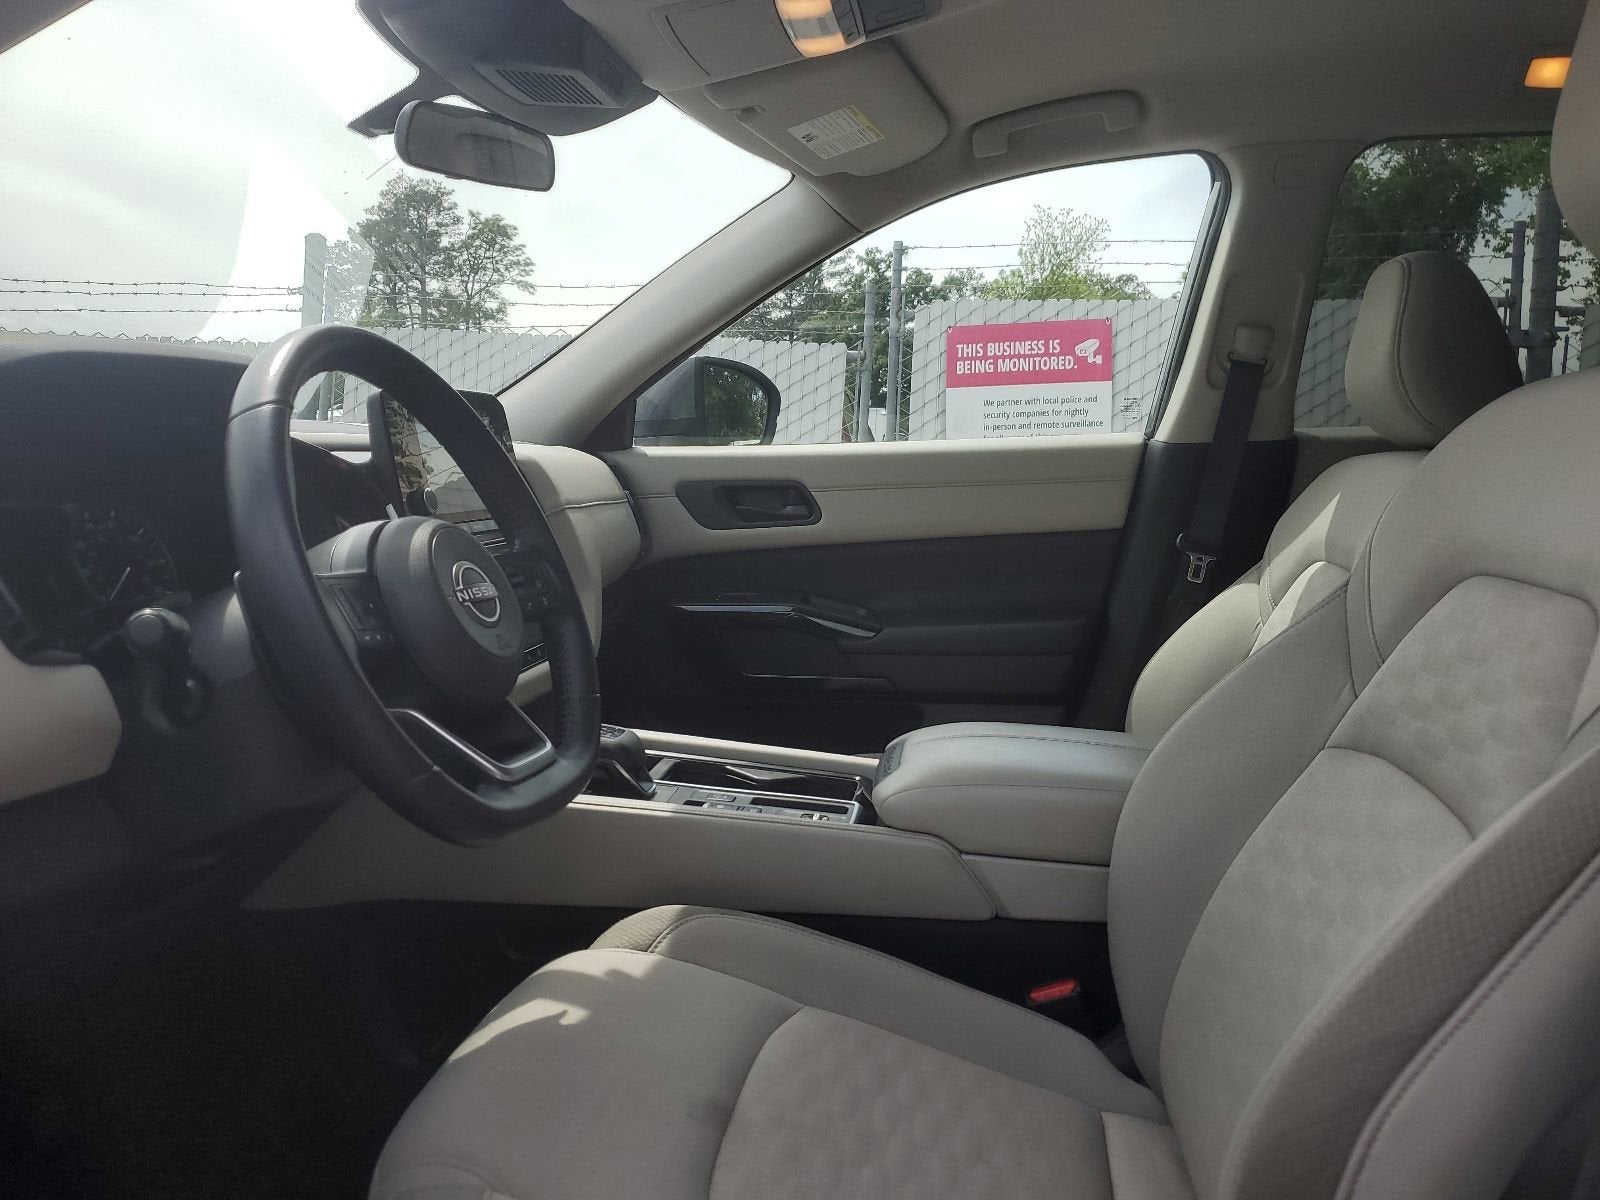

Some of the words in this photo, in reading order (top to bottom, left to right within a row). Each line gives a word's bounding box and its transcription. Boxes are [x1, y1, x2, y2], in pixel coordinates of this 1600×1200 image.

[956, 343, 984, 358] THIS
[987, 340, 1045, 356] BUSINESS
[1049, 339, 1060, 353] IS
[956, 359, 994, 375] BEING
[997, 355, 1078, 373] MONITORED.
[983, 399, 994, 407] We
[996, 399, 1022, 408] partner
[1024, 397, 1041, 405] with
[1042, 396, 1059, 405] local
[1060, 396, 1082, 406] police
[1083, 395, 1098, 403] and
[983, 411, 1010, 420] security
[1012, 409, 1050, 419] companies
[1051, 408, 1062, 417] for
[1064, 407, 1089, 418] nightly
[983, 422, 1016, 432] in-person
[1018, 421, 1032, 430] and
[1034, 421, 1060, 429] remote
[1061, 419, 1104, 429] surveillance
